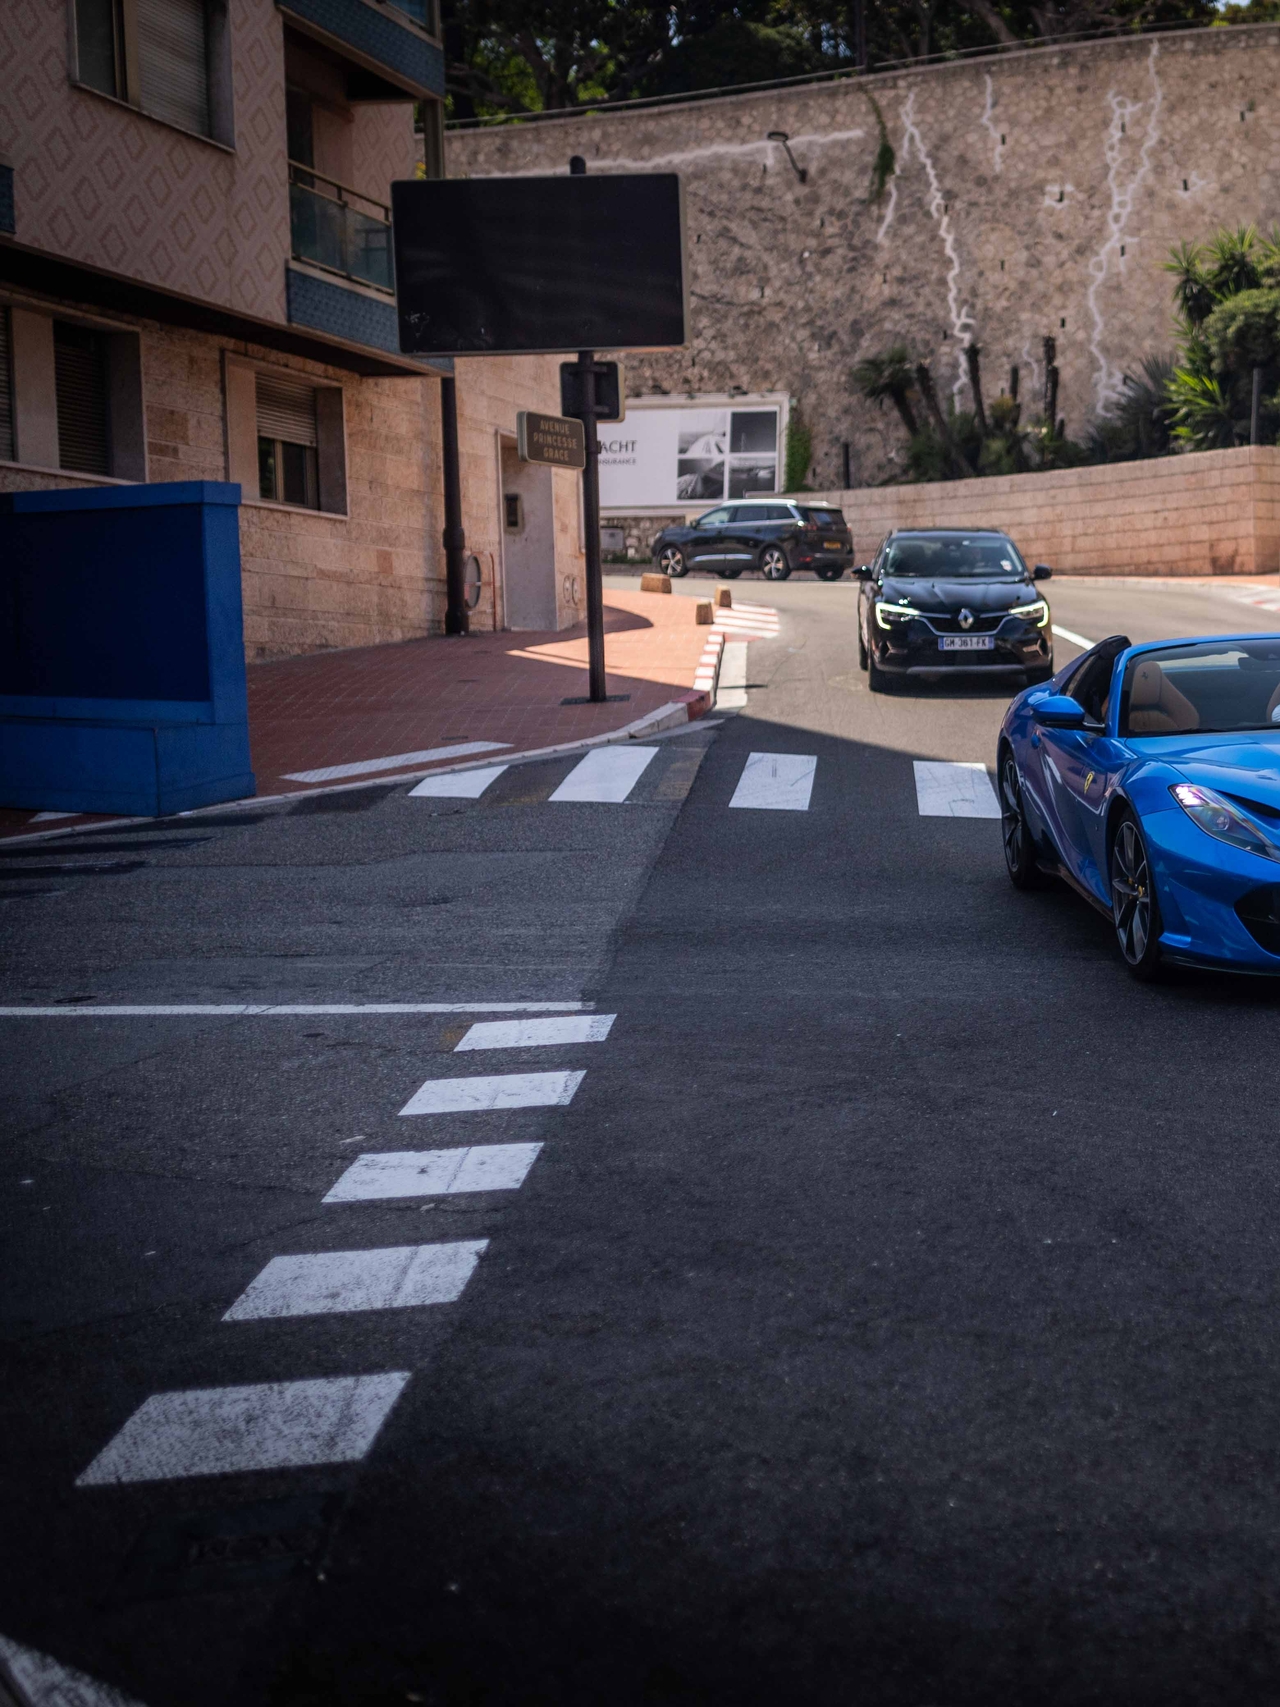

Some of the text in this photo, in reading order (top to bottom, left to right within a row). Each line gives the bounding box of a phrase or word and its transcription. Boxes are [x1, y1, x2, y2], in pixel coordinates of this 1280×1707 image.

[540, 420, 570, 434] AVENUE
[533, 432, 577, 449] PRINCESSE
[599, 440, 637, 454] ACHT
[543, 447, 569, 461] GRACE
[599, 457, 637, 466] NSURANCE
